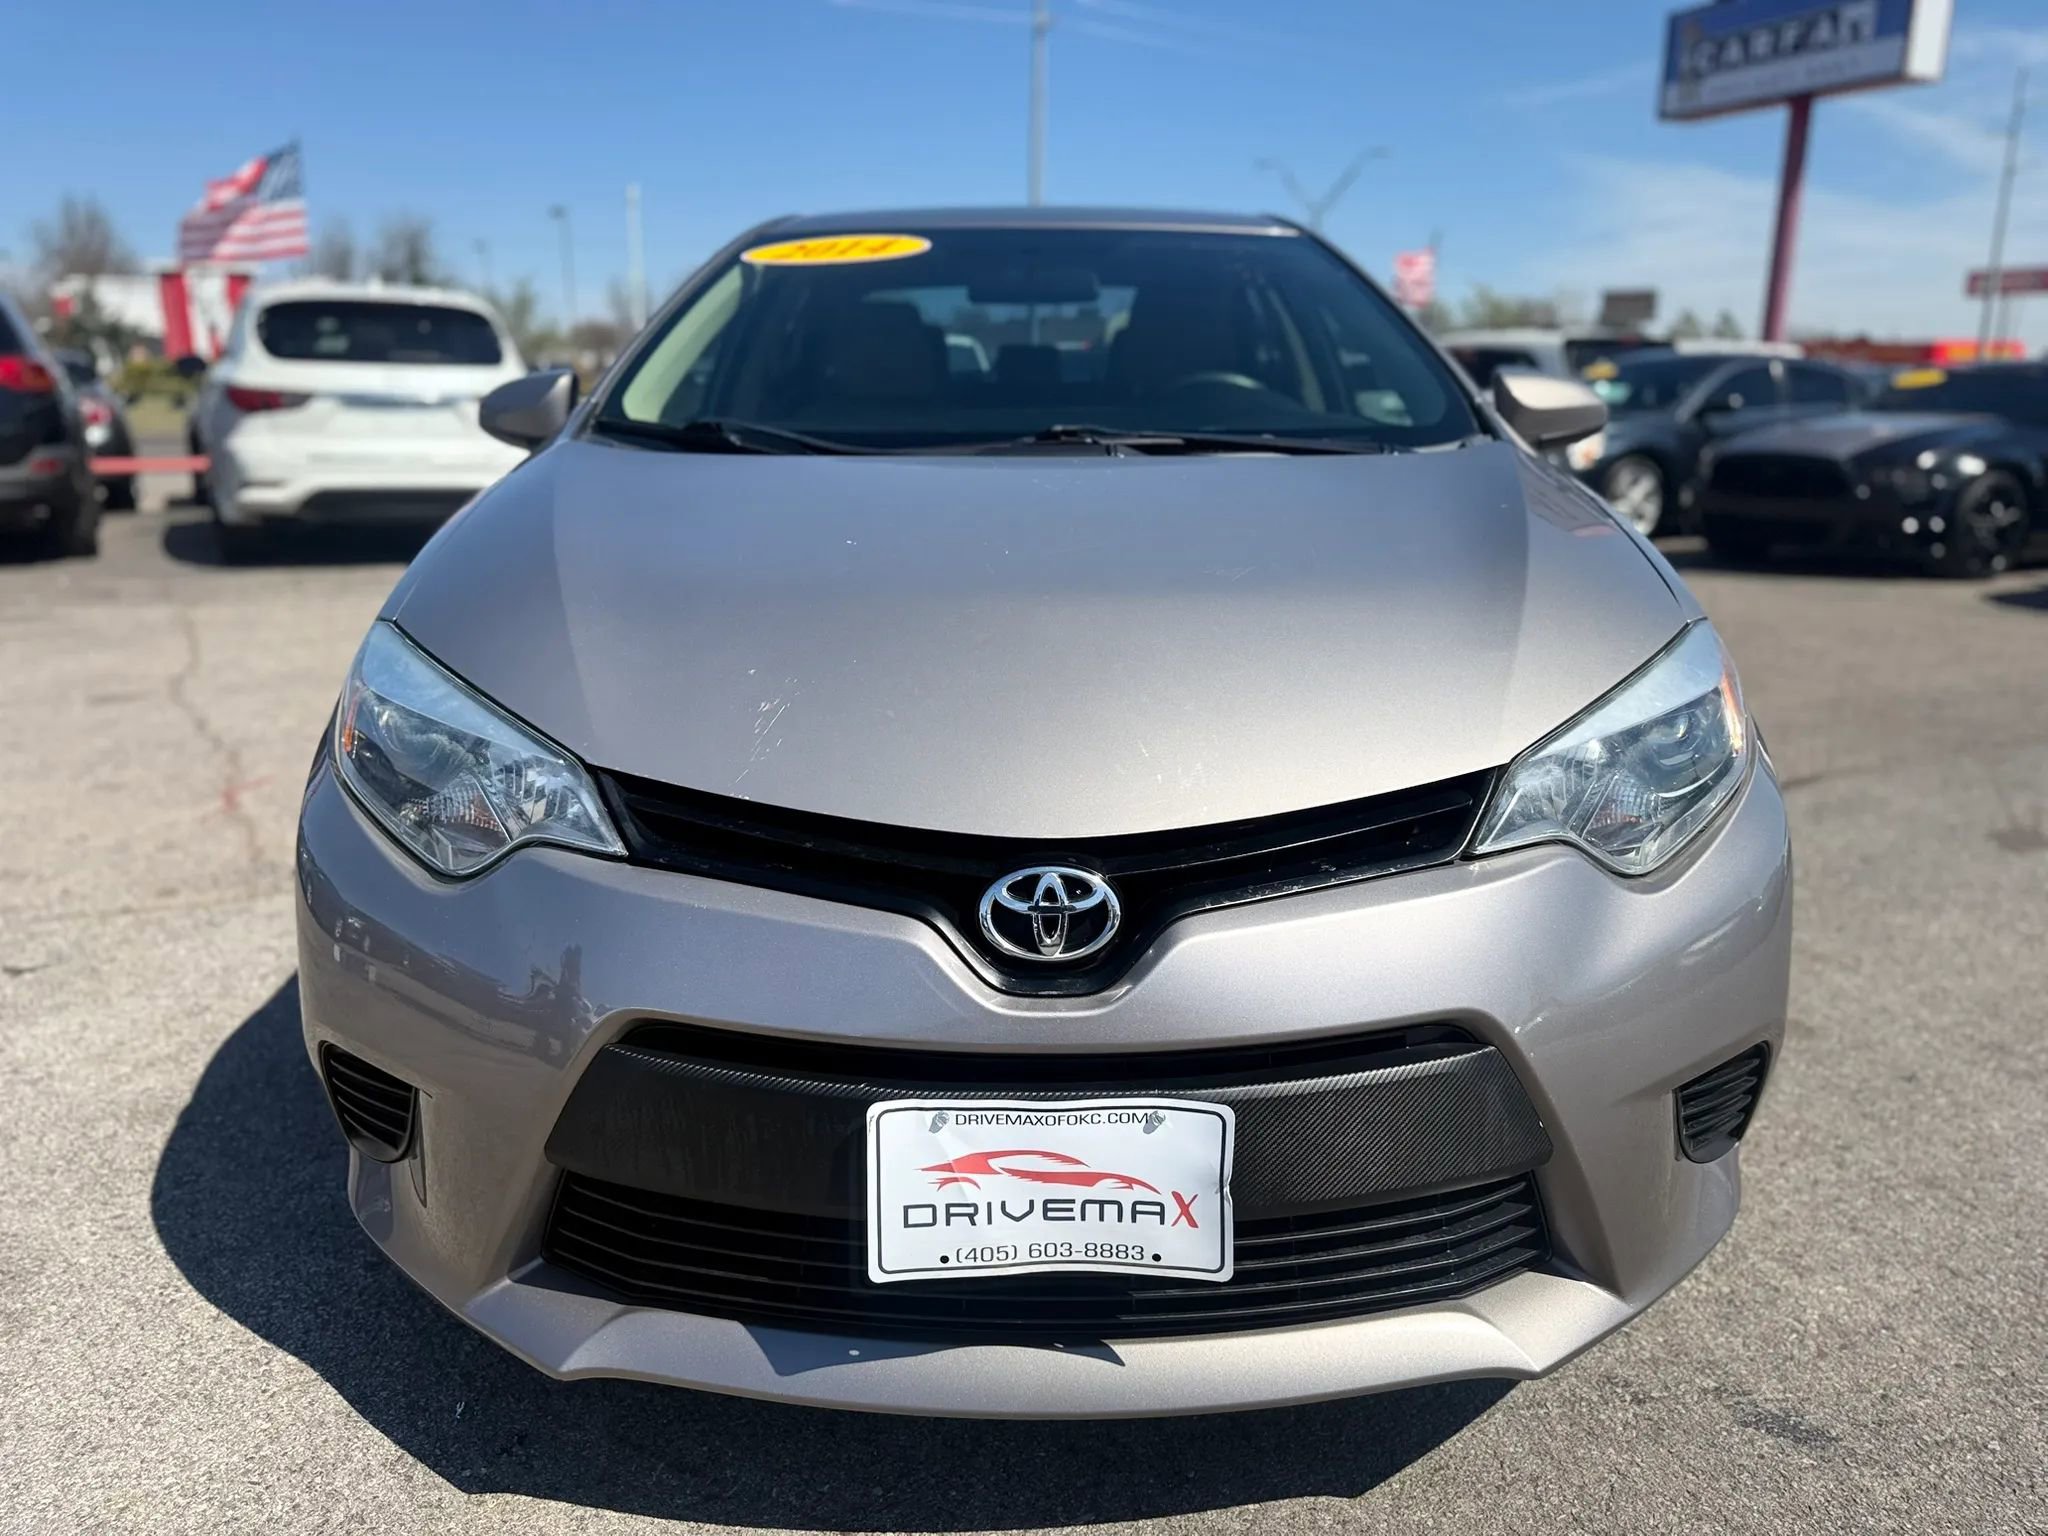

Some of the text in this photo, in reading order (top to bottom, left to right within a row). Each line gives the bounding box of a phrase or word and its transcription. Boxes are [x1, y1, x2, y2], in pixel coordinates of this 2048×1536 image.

[770, 238, 899, 260] 2014
[955, 1112, 1149, 1127] DRIVEMAXOFOKC.COM
[903, 1190, 1199, 1229] DRIVEMAX
[956, 1242, 1145, 1264] (405) 603-8883
